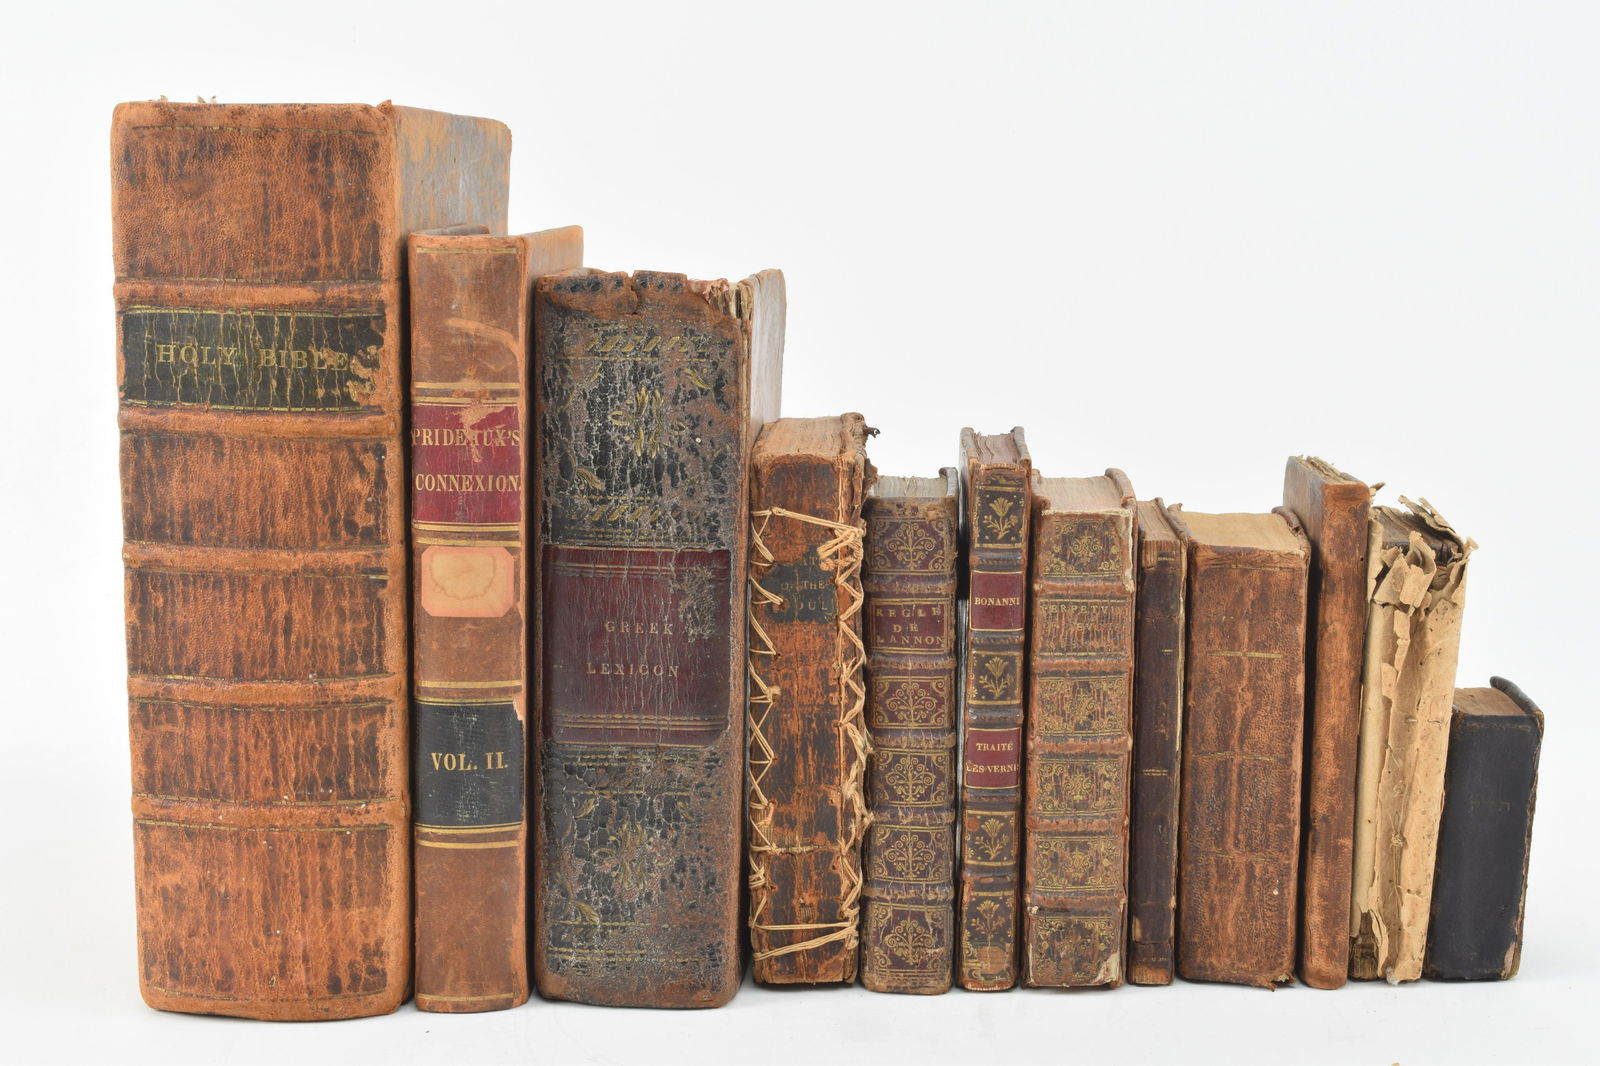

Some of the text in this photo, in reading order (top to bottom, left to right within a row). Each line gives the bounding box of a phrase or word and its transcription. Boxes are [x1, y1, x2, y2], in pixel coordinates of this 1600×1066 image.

[157, 345, 349, 371] HOLY BIBLE
[803, 580, 825, 590] THE
[974, 597, 1020, 606] BONANNI
[605, 621, 674, 635] GREEK
[893, 622, 919, 633] DE
[586, 662, 679, 678] LEXICON
[431, 751, 509, 771] VOL. II.
